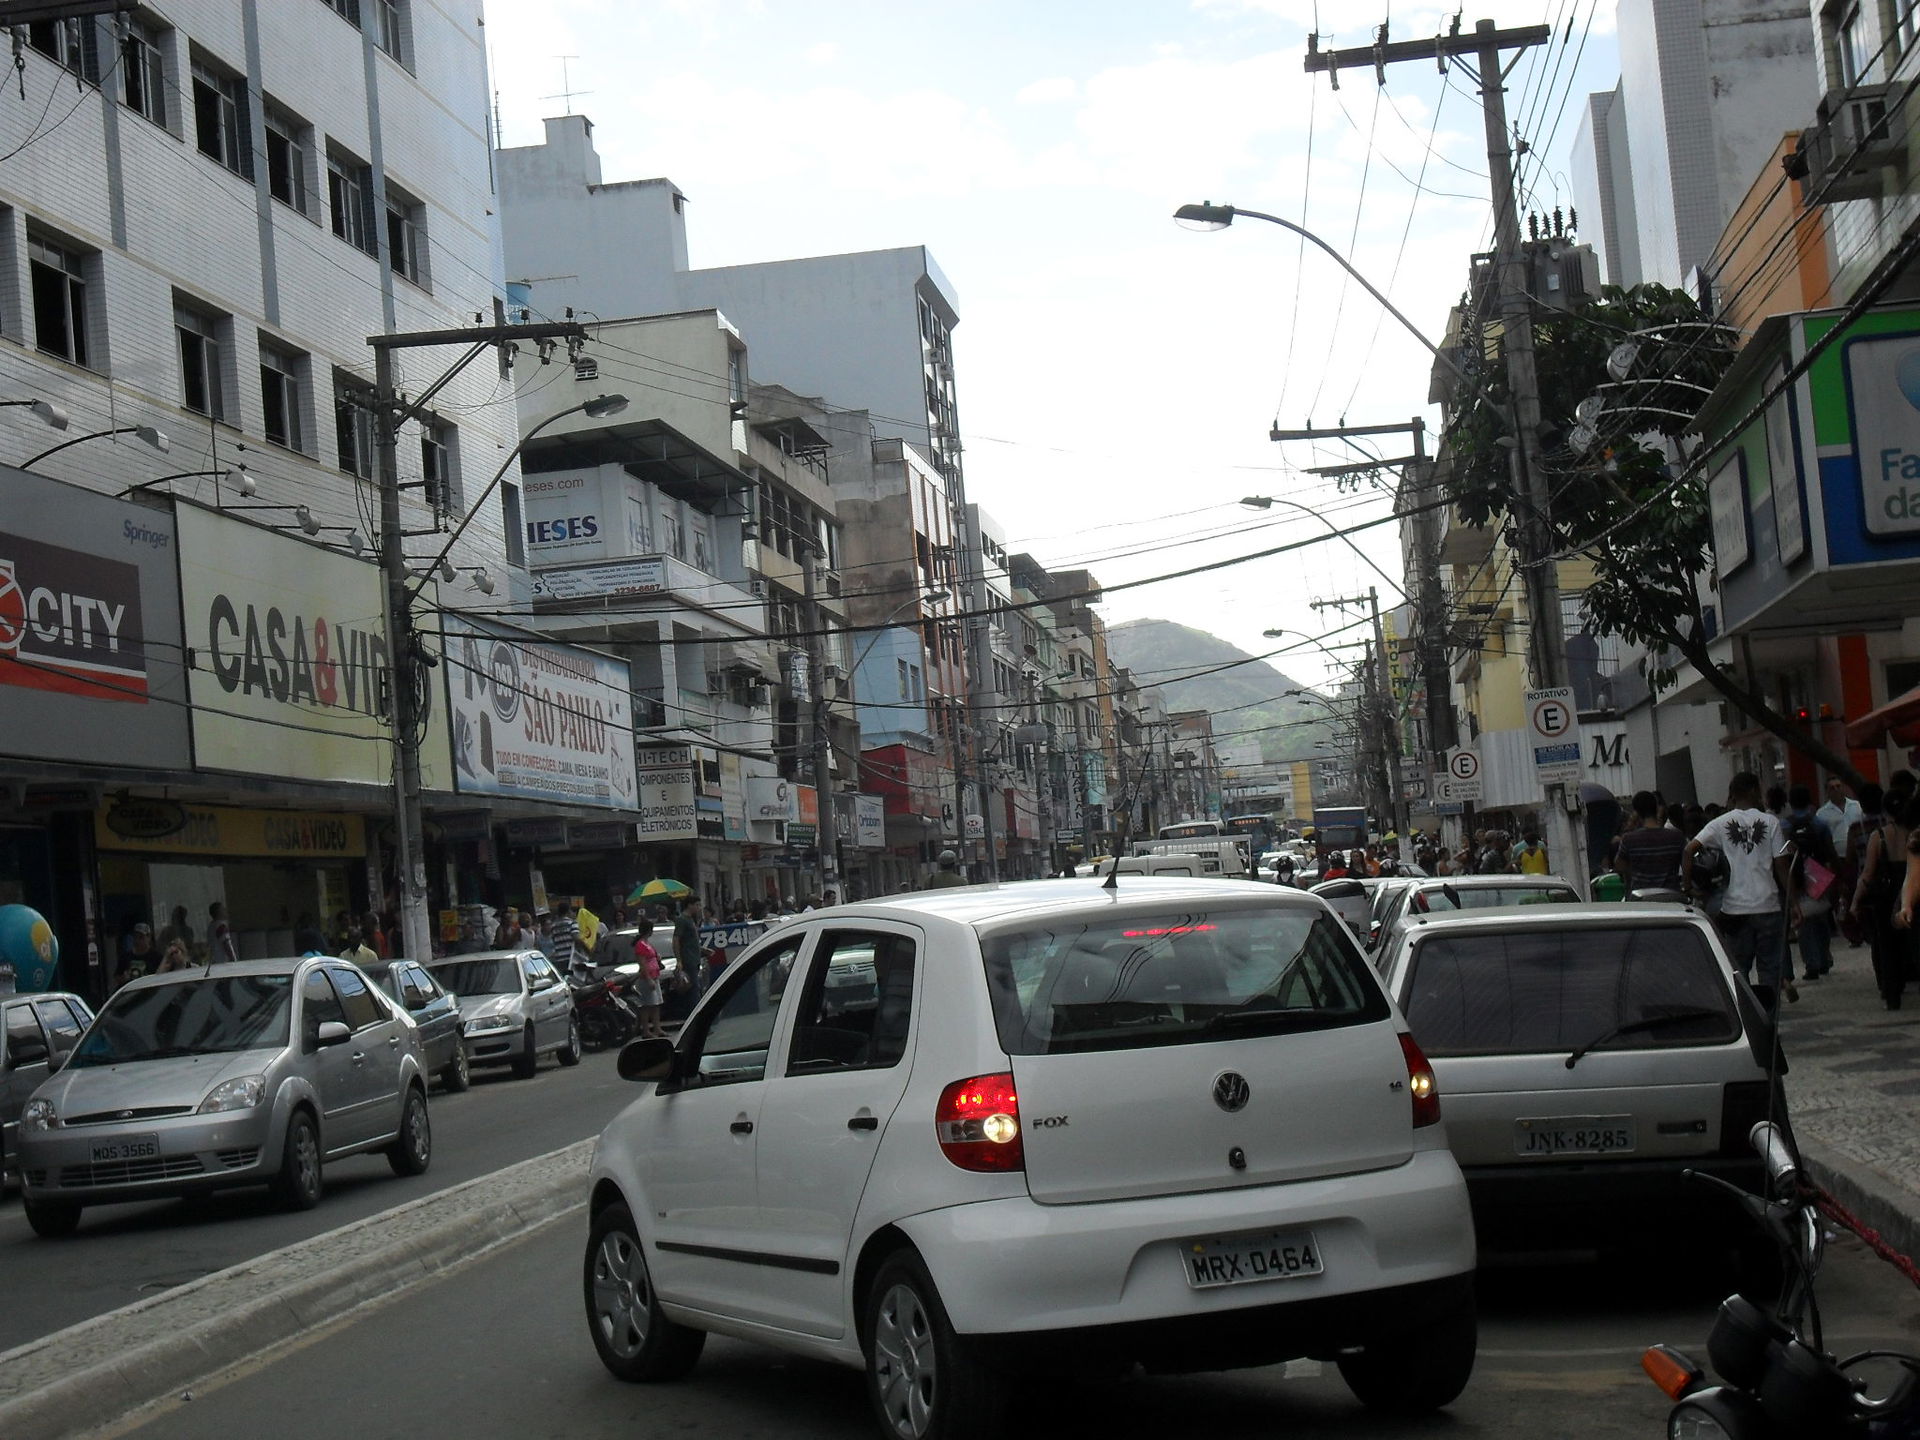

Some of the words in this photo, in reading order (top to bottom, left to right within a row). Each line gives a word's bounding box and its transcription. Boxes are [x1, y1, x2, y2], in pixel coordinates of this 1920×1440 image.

[123, 519, 170, 549] Springer
[530, 582, 542, 594] S
[28, 586, 126, 653] CITY
[1527, 689, 1569, 701] ROTATIVO
[557, 691, 605, 755] PAULO
[1543, 708, 1561, 730] E
[1588, 733, 1630, 768] M
[1460, 758, 1470, 774] E
[640, 773, 690, 786] OMPONENTES
[661, 790, 667, 801] E
[642, 805, 694, 819] QUIPAMENTOS
[641, 817, 692, 833] ELETRÔNICOS
[1033, 1114, 1069, 1130] FOX
